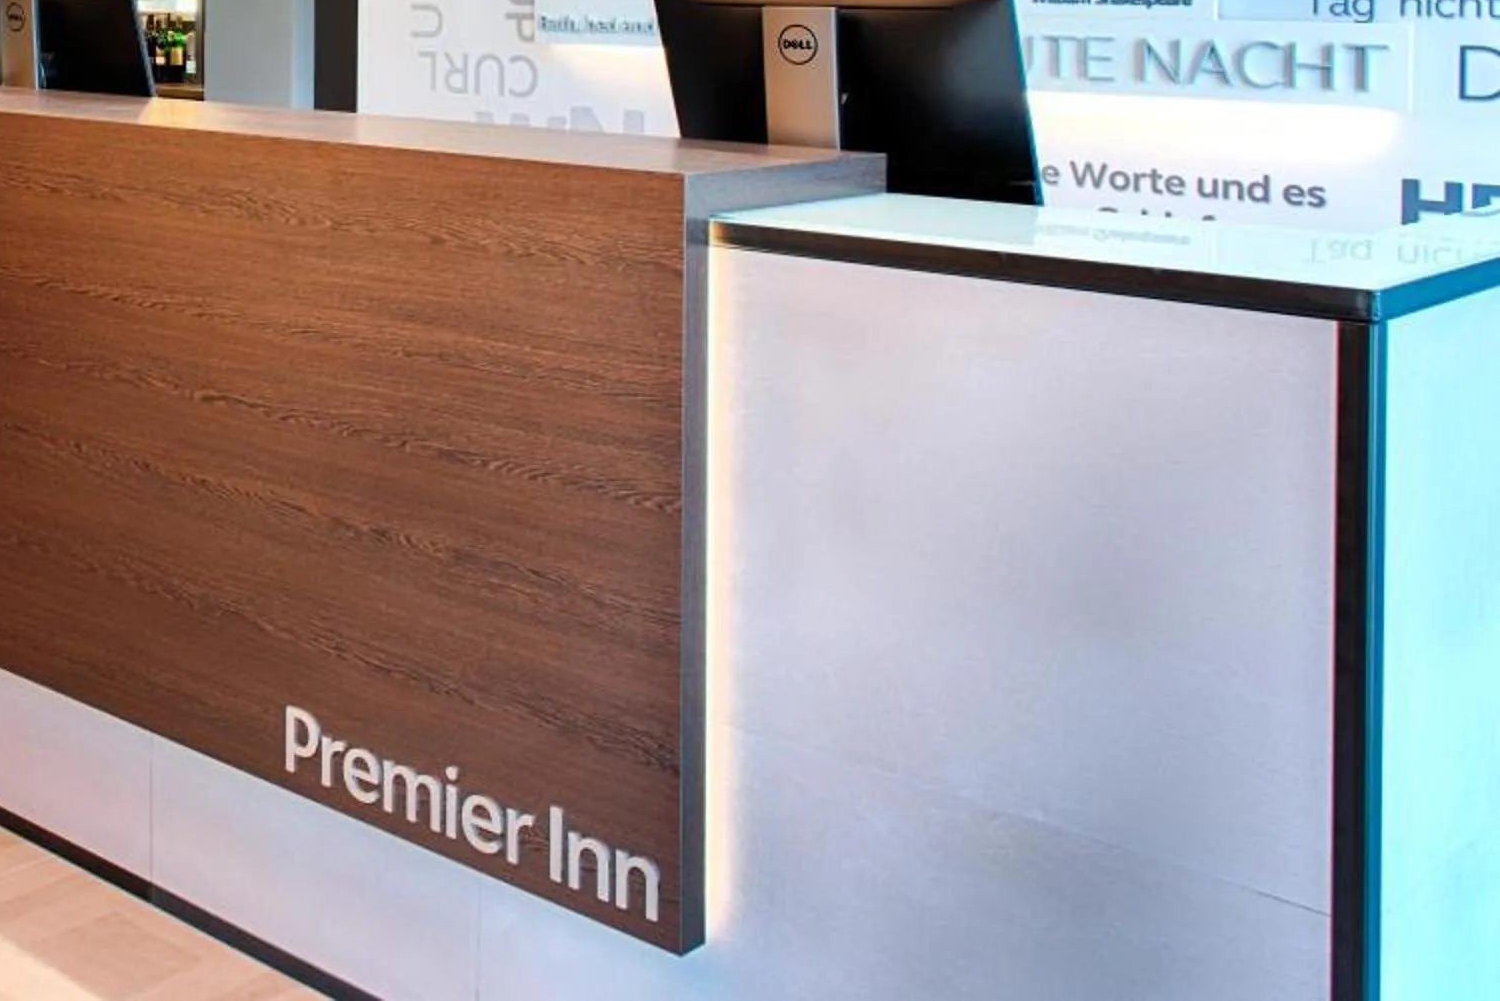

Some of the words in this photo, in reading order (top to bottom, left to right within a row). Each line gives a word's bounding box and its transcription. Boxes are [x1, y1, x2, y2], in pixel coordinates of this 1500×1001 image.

[783, 39, 812, 49] DELL
[1134, 37, 1388, 92] NACHT
[419, 51, 538, 97] CURL
[1070, 160, 1186, 196] Worte
[1196, 175, 1270, 204] und
[1283, 180, 1327, 208] es
[285, 704, 535, 866] Premier
[548, 806, 660, 922] Inn
